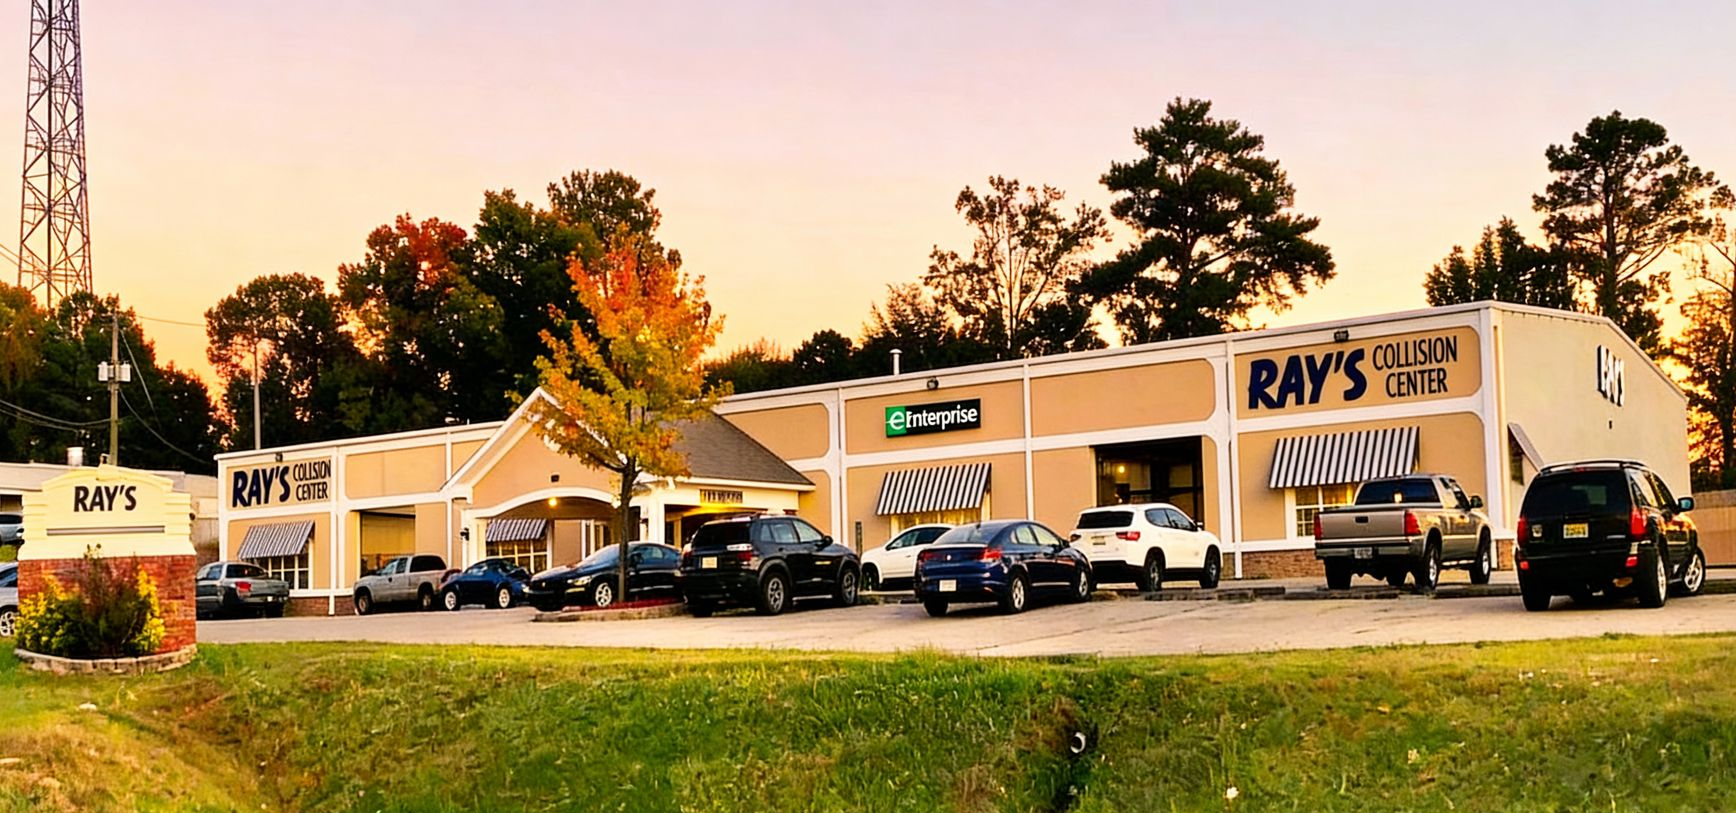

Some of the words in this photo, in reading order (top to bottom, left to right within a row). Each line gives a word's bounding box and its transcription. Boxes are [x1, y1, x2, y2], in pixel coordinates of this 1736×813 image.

[1372, 335, 1458, 371] COLLISION
[1248, 348, 1368, 410] RAY'S
[1385, 367, 1448, 398] CENTER
[73, 484, 137, 512] RAY'S
[232, 465, 291, 508] RAY'S
